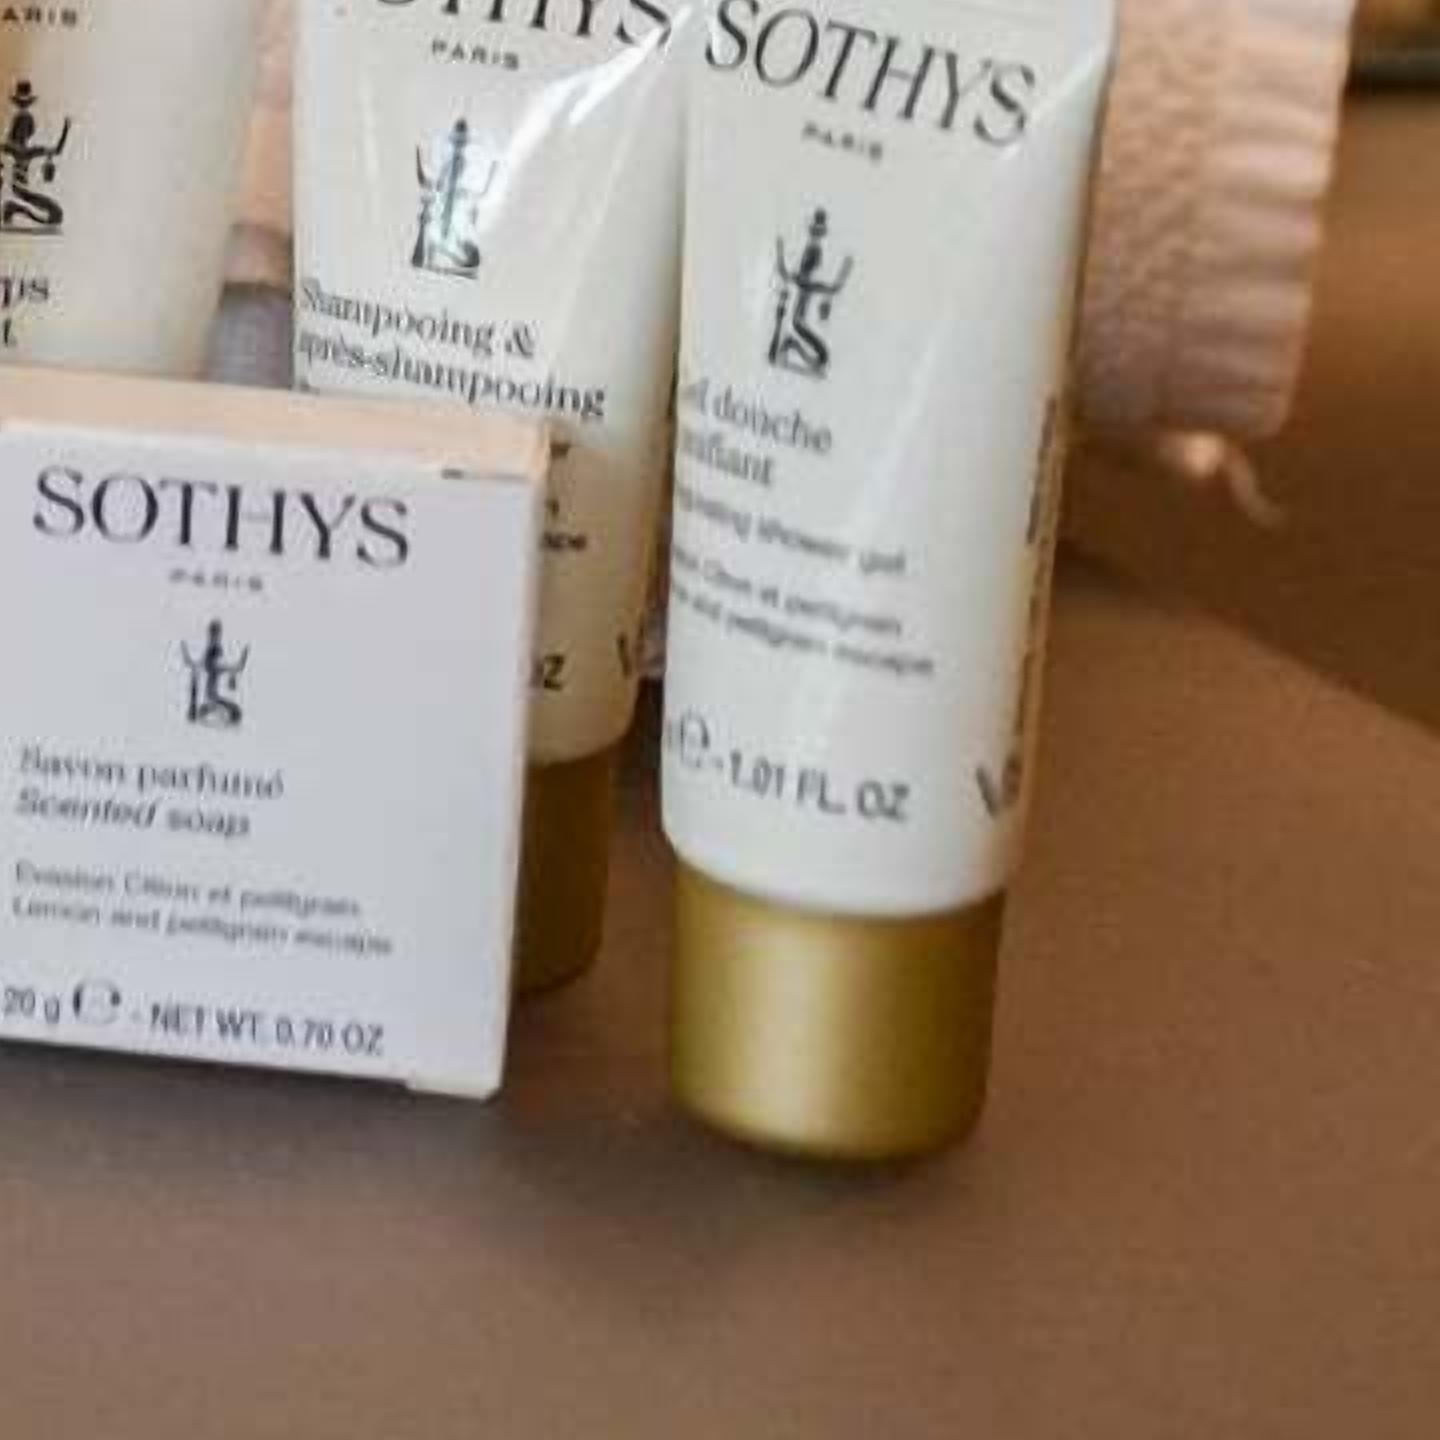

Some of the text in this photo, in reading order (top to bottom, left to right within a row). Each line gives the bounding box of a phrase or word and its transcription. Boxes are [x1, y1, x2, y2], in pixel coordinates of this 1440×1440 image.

[431, 38, 519, 72] PARIS
[801, 120, 883, 161] PARIS
[503, 322, 537, 358] &
[712, 384, 832, 455] douche
[32, 466, 409, 569] SOTHYS
[20, 744, 284, 800] Savon parfumé
[17, 787, 251, 840] Scented soap
[856, 780, 910, 823] OZ
[3, 986, 36, 1017] 20
[44, 997, 61, 1025] g
[151, 1004, 206, 1037] NET
[275, 1016, 335, 1051] 0.70
[341, 1022, 385, 1057] OZ
